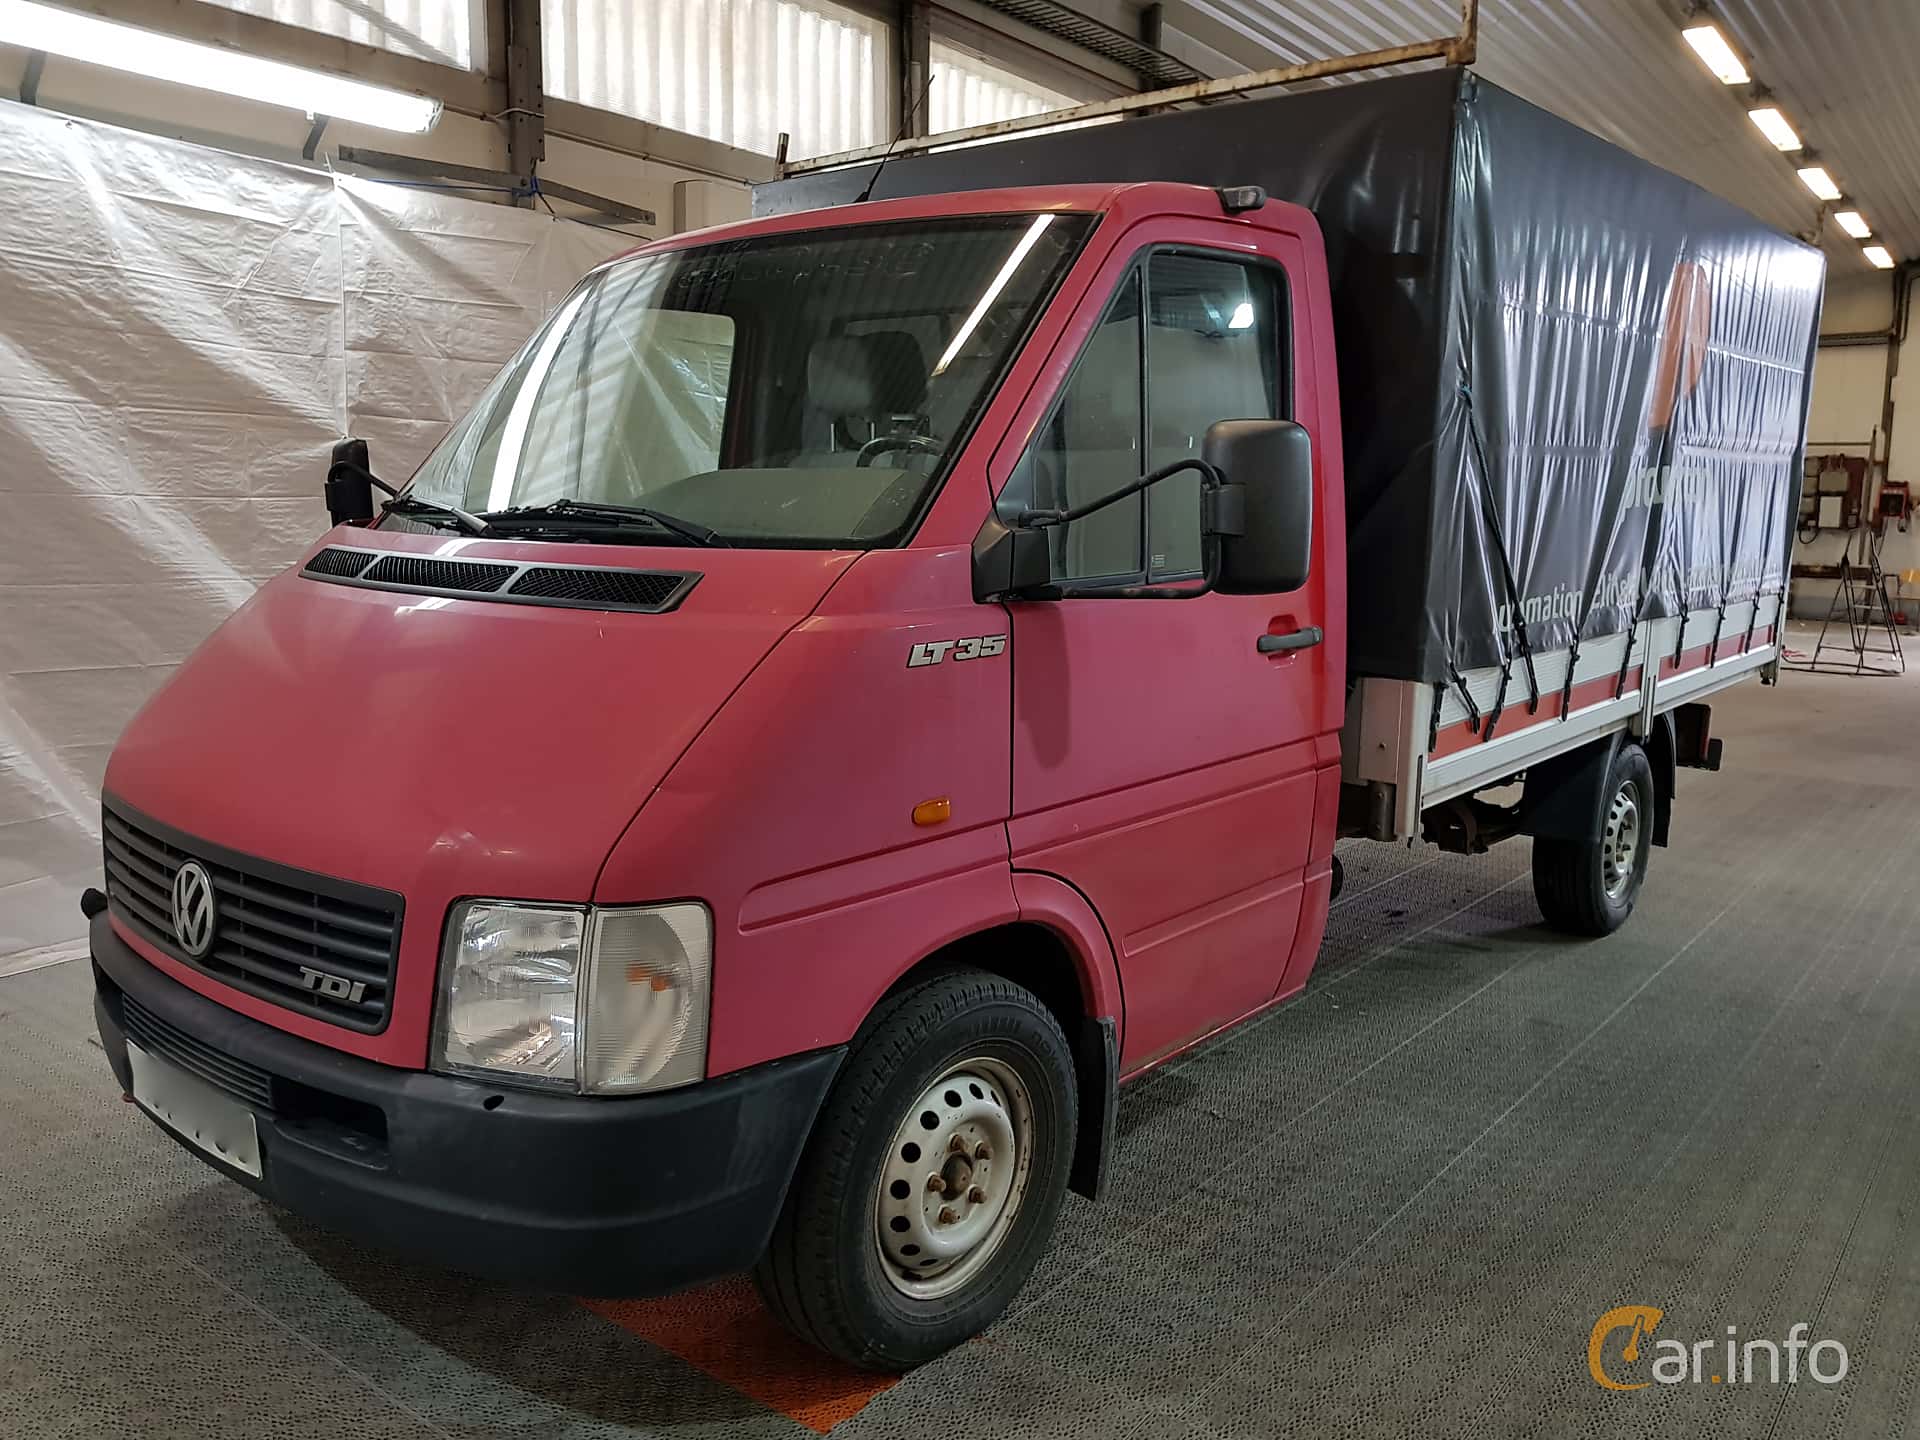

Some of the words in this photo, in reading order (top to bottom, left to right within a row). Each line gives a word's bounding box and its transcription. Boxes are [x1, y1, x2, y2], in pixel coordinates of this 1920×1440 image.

[907, 640, 954, 668] LT
[953, 634, 1007, 661] 35
[300, 966, 367, 1003] TDI
